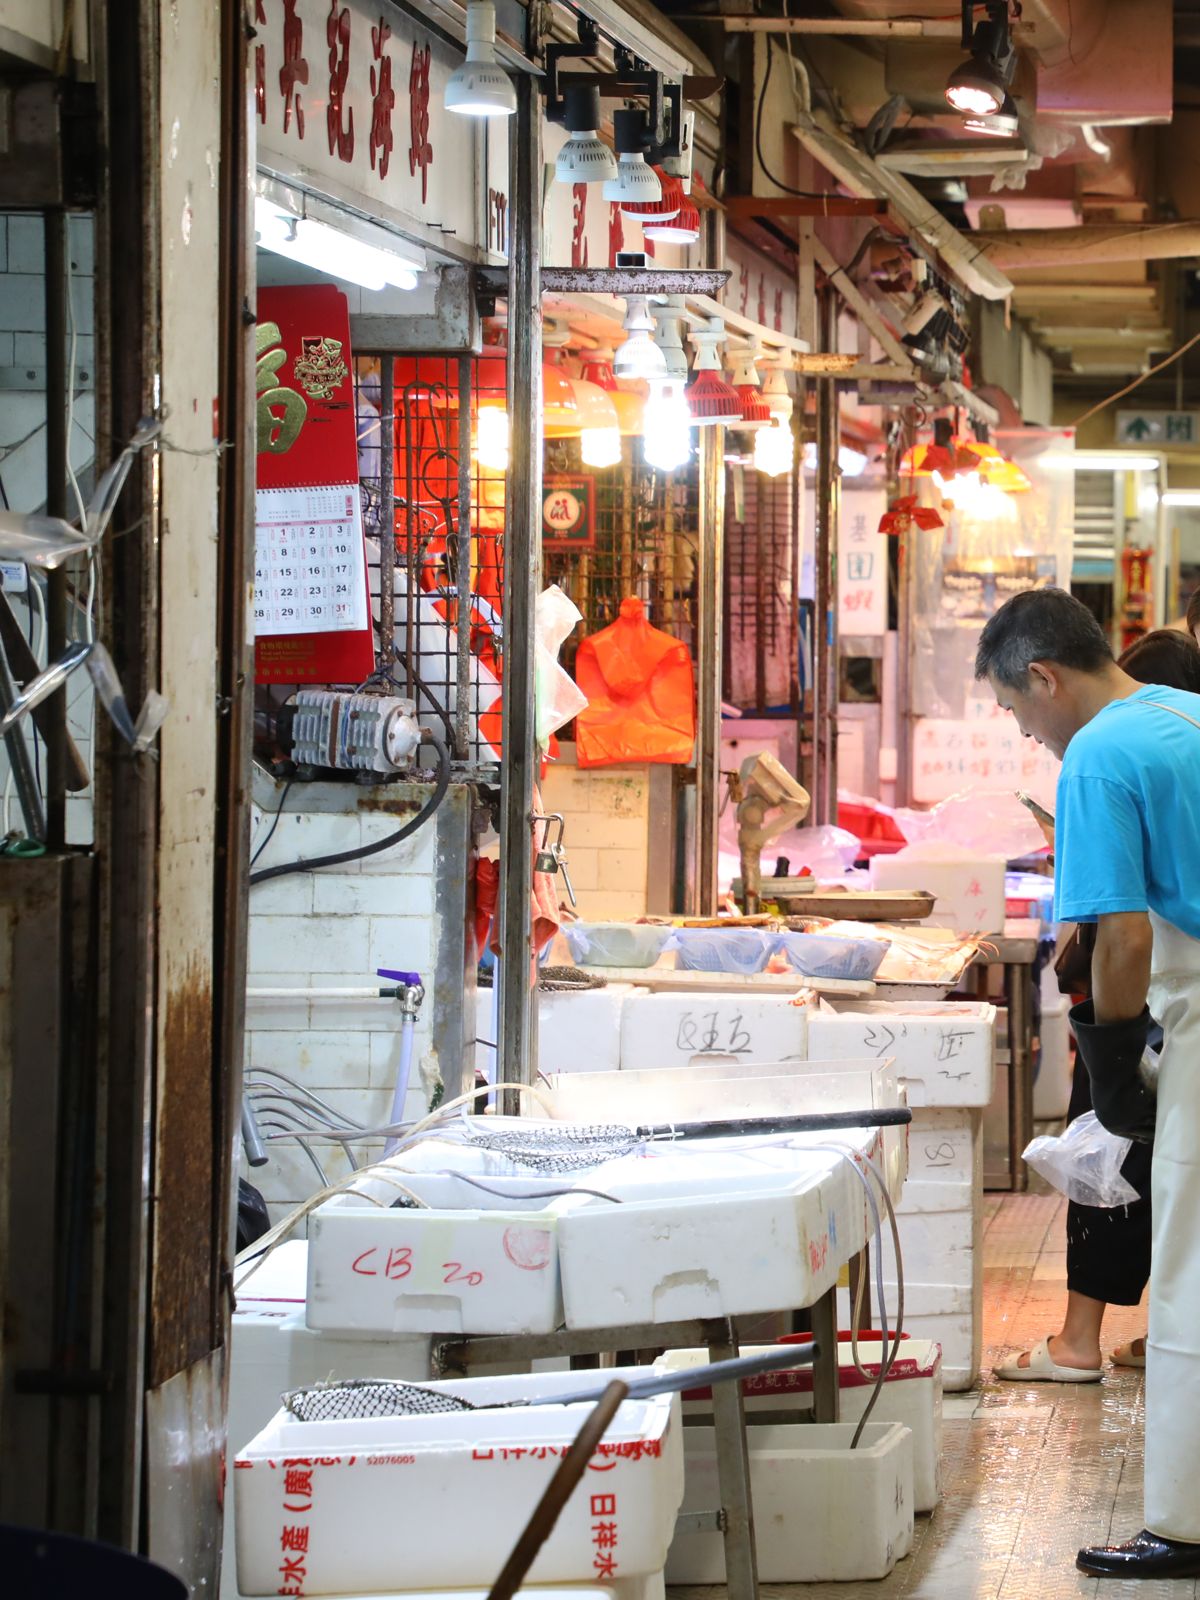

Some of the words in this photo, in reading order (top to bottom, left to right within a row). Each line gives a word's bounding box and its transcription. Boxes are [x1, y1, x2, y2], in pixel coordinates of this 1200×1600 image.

[309, 526, 315, 535] 2
[337, 525, 343, 534] 3
[281, 548, 288, 557] 8
[310, 547, 316, 555] 9
[335, 545, 347, 553] 10
[279, 568, 292, 576] 15
[309, 566, 320, 575] 16
[335, 564, 347, 573] 17
[280, 588, 293, 596] 22
[309, 586, 321, 595] 23
[336, 584, 347, 593] 24
[281, 608, 294, 616] 29
[310, 606, 322, 615] 30
[336, 604, 346, 612] 31
[352, 1247, 413, 1280] CB
[442, 1262, 482, 1286] 20
